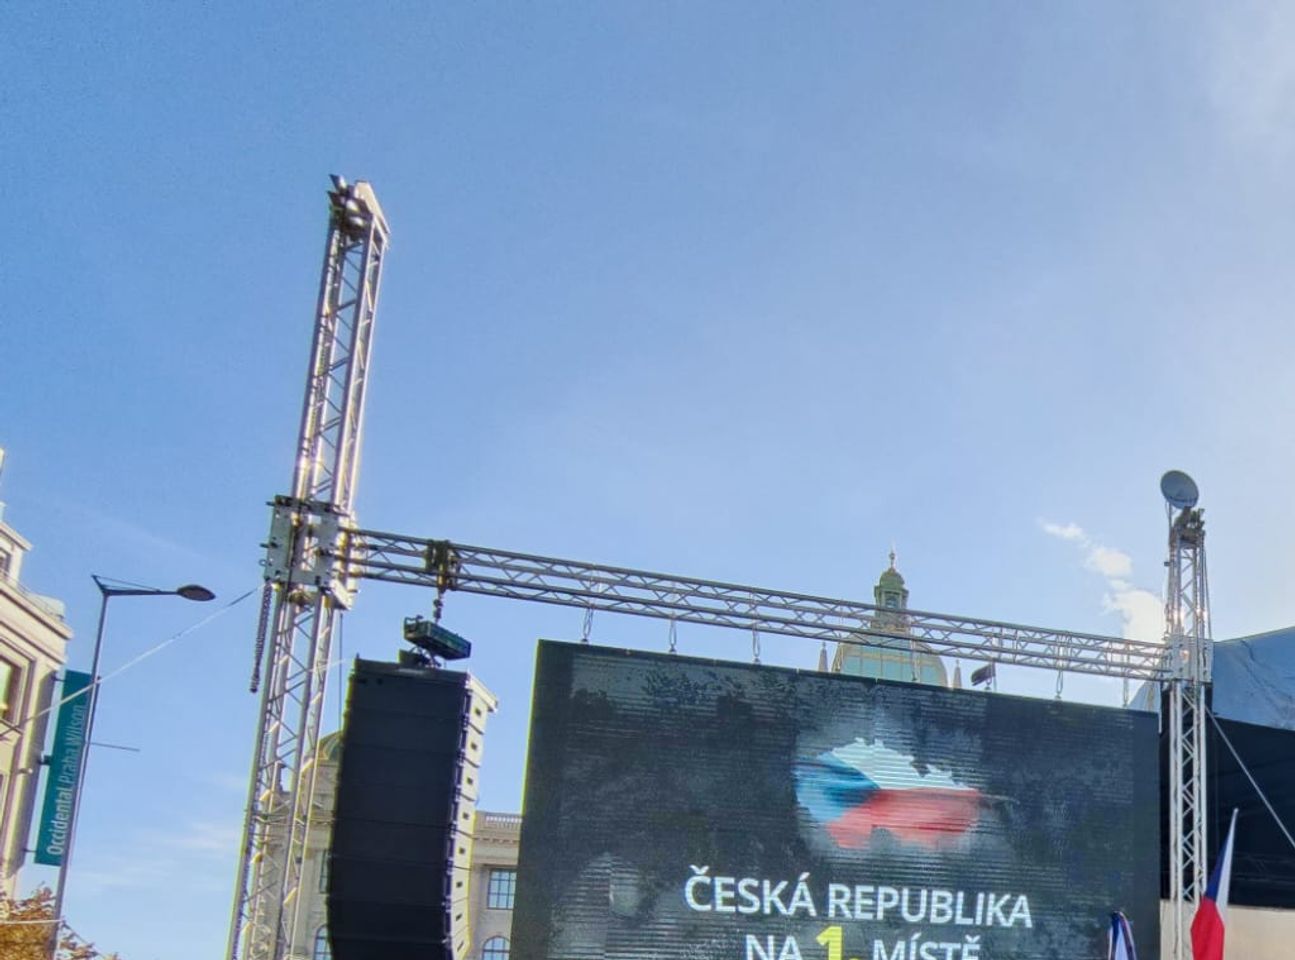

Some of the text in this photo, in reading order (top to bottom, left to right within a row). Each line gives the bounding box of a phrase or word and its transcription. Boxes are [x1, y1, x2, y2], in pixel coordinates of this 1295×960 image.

[46, 704, 86, 856] Occidental Praha Wilson
[684, 865, 1034, 928] ČESKÁ REPUBLIKA
